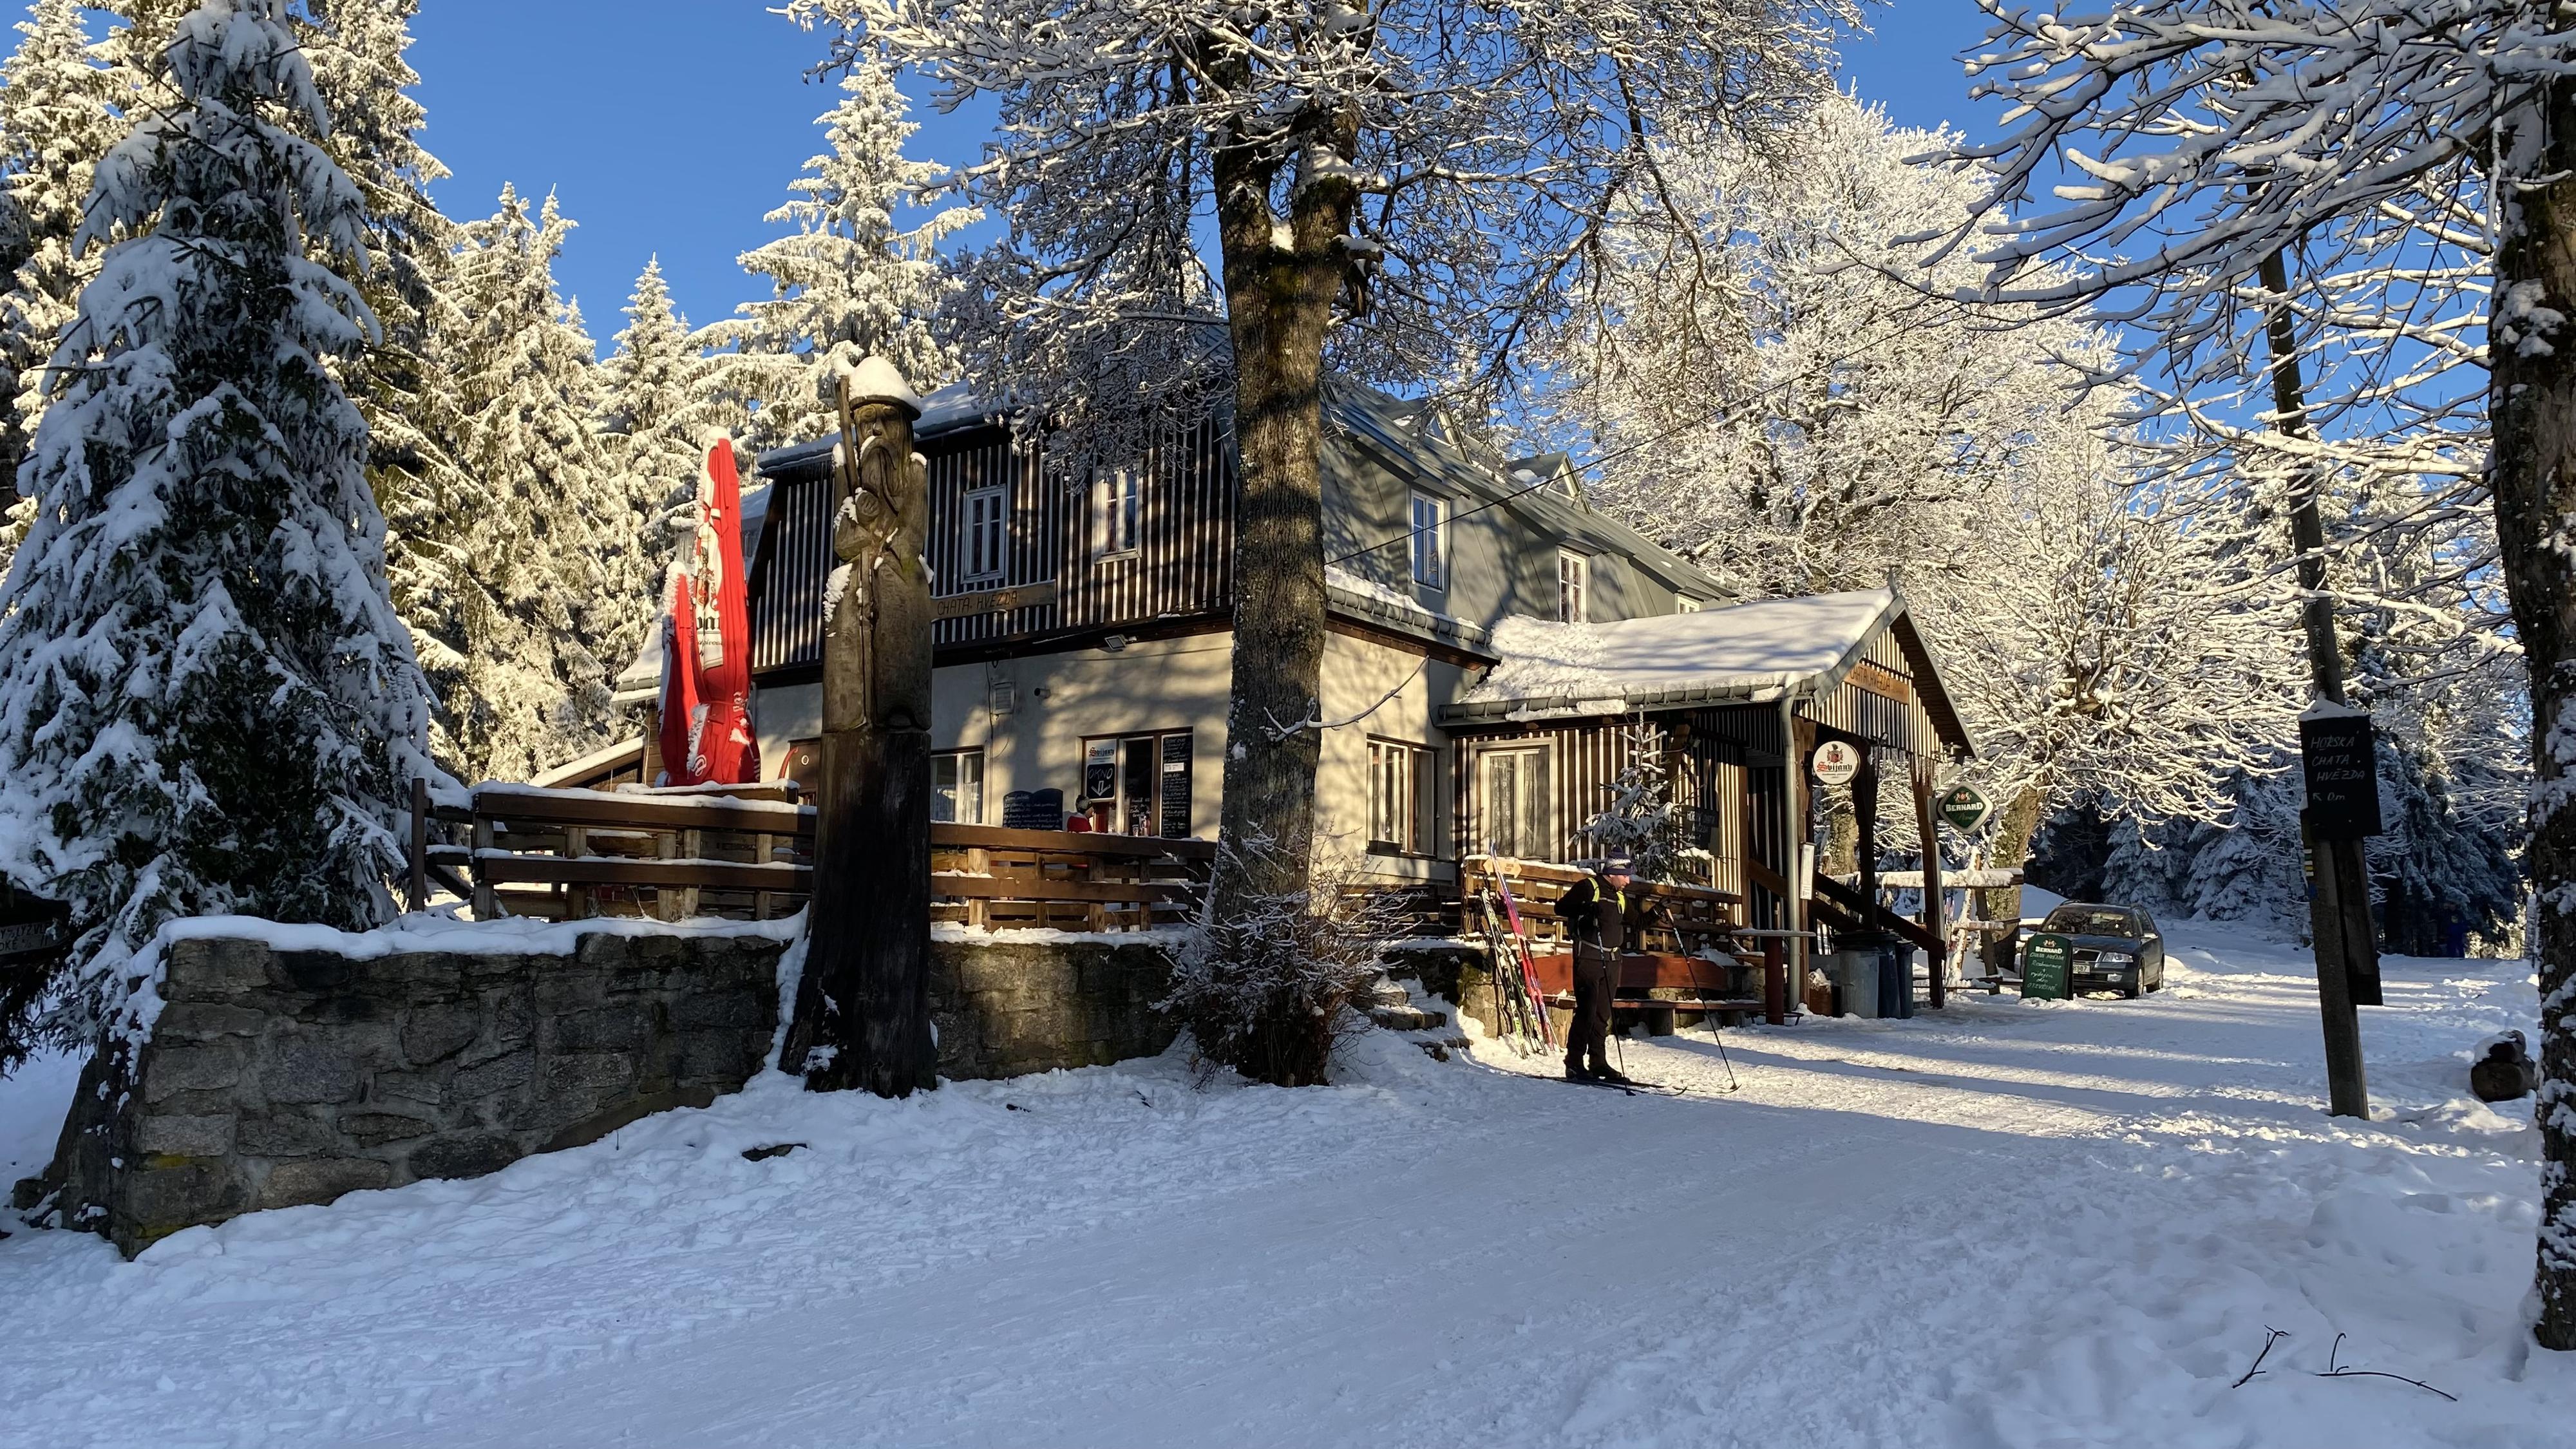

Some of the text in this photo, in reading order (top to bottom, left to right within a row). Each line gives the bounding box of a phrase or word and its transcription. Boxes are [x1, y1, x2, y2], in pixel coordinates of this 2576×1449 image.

[2312, 754, 2350, 766] CHATA
[1816, 761, 1853, 772] Svijany
[1088, 768, 1113, 780] OKNO
[1946, 802, 1984, 812] BERNARD
